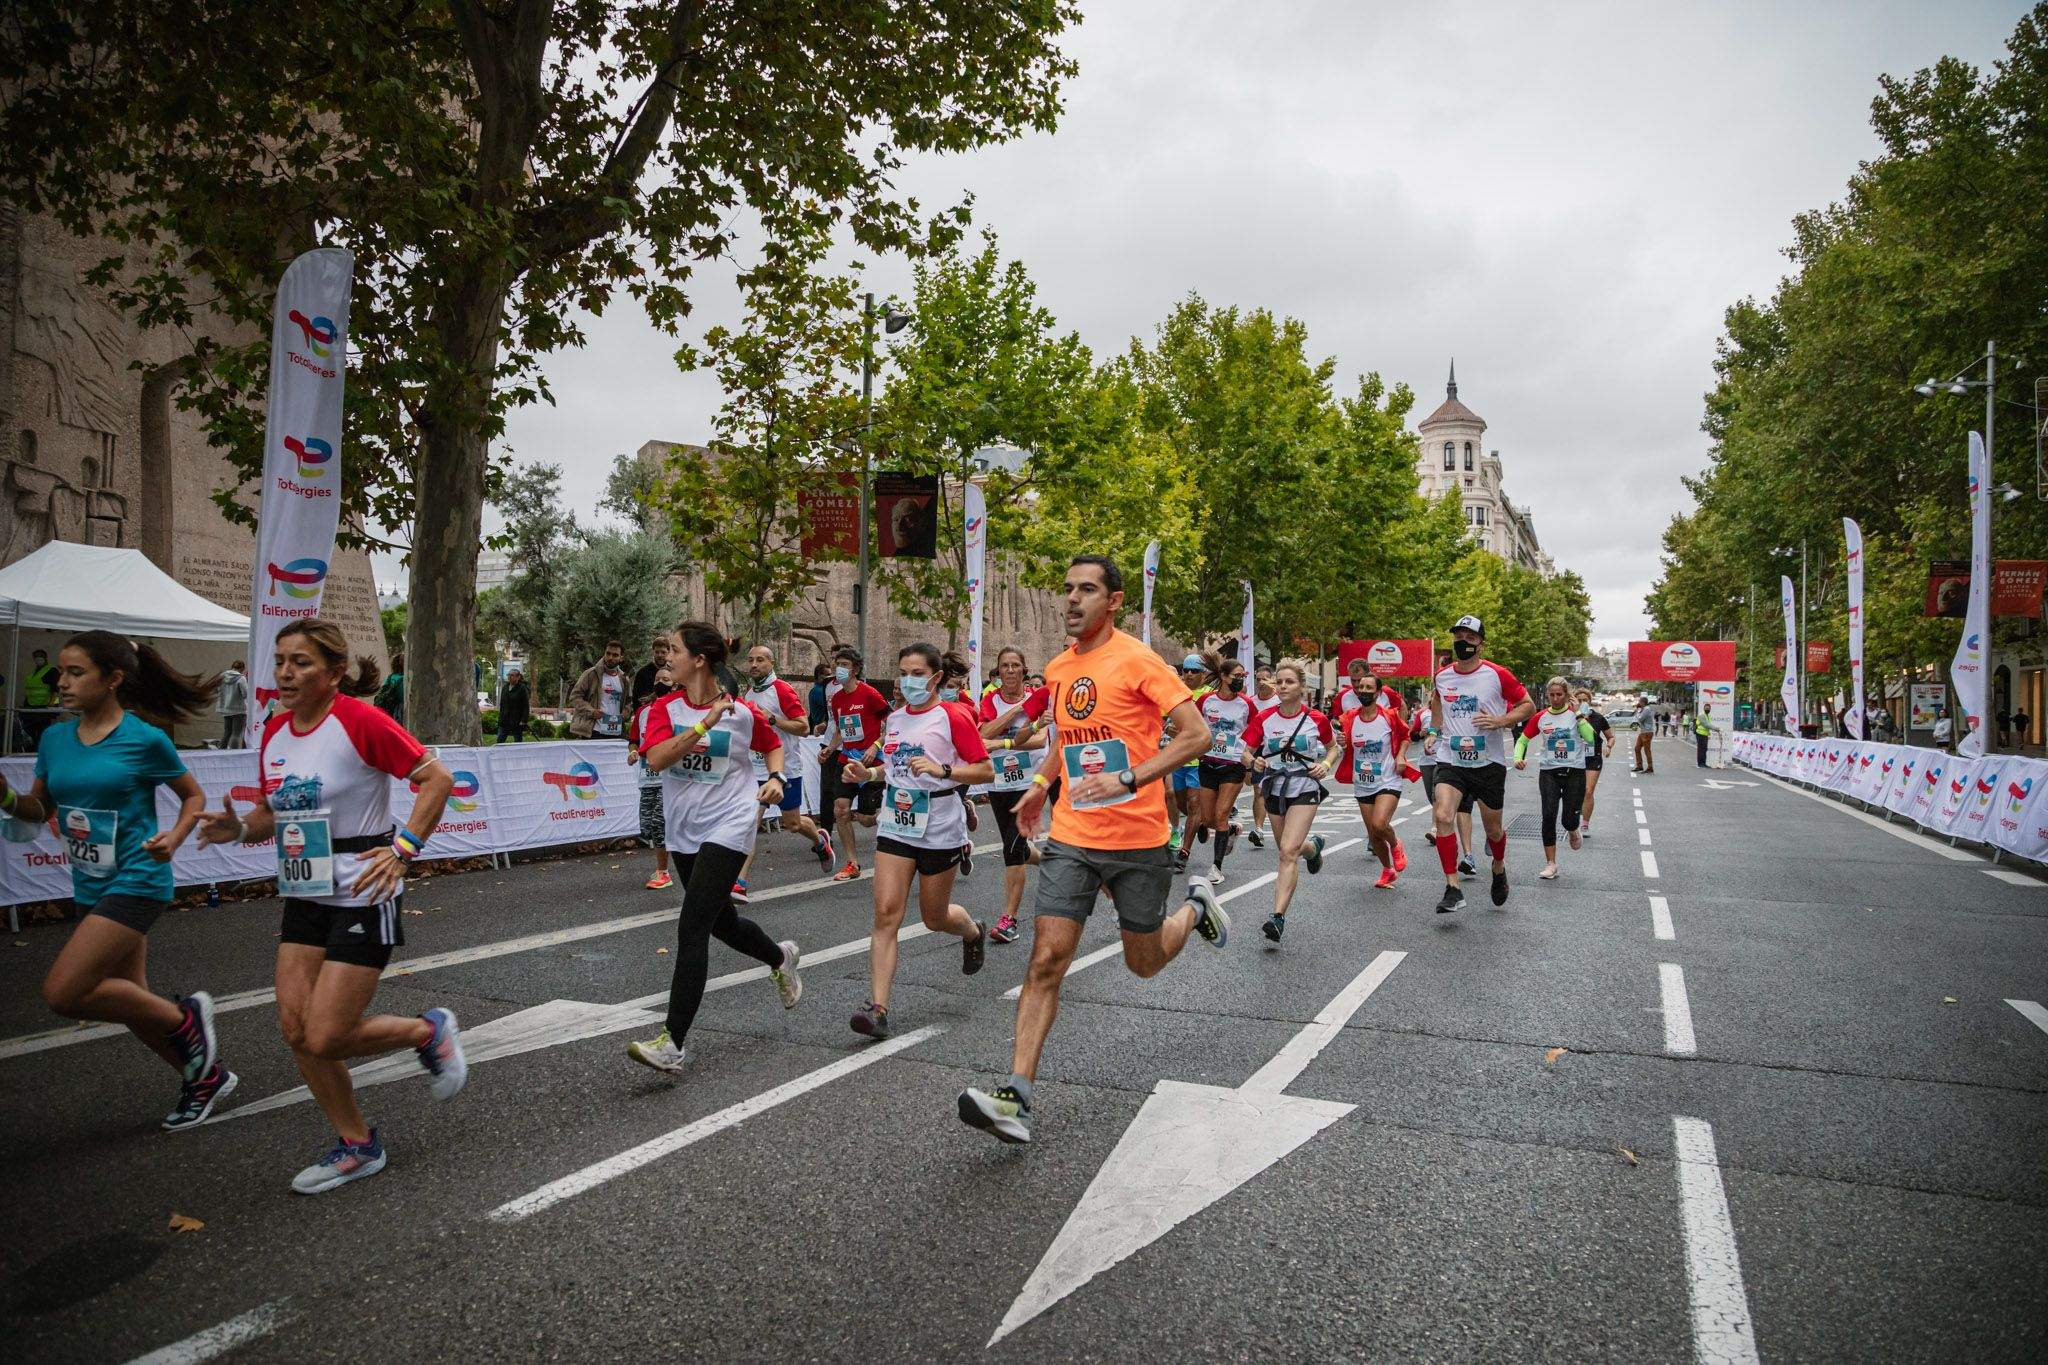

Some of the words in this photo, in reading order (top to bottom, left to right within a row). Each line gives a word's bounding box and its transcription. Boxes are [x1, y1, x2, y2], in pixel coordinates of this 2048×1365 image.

[1458, 751, 1479, 761] 1223
[1554, 750, 1568, 759] 548
[682, 754, 712, 772] 528
[1003, 770, 1025, 783] 568
[550, 807, 605, 820] TotalEnergies
[894, 810, 916, 827] 564
[284, 858, 312, 881] 600
